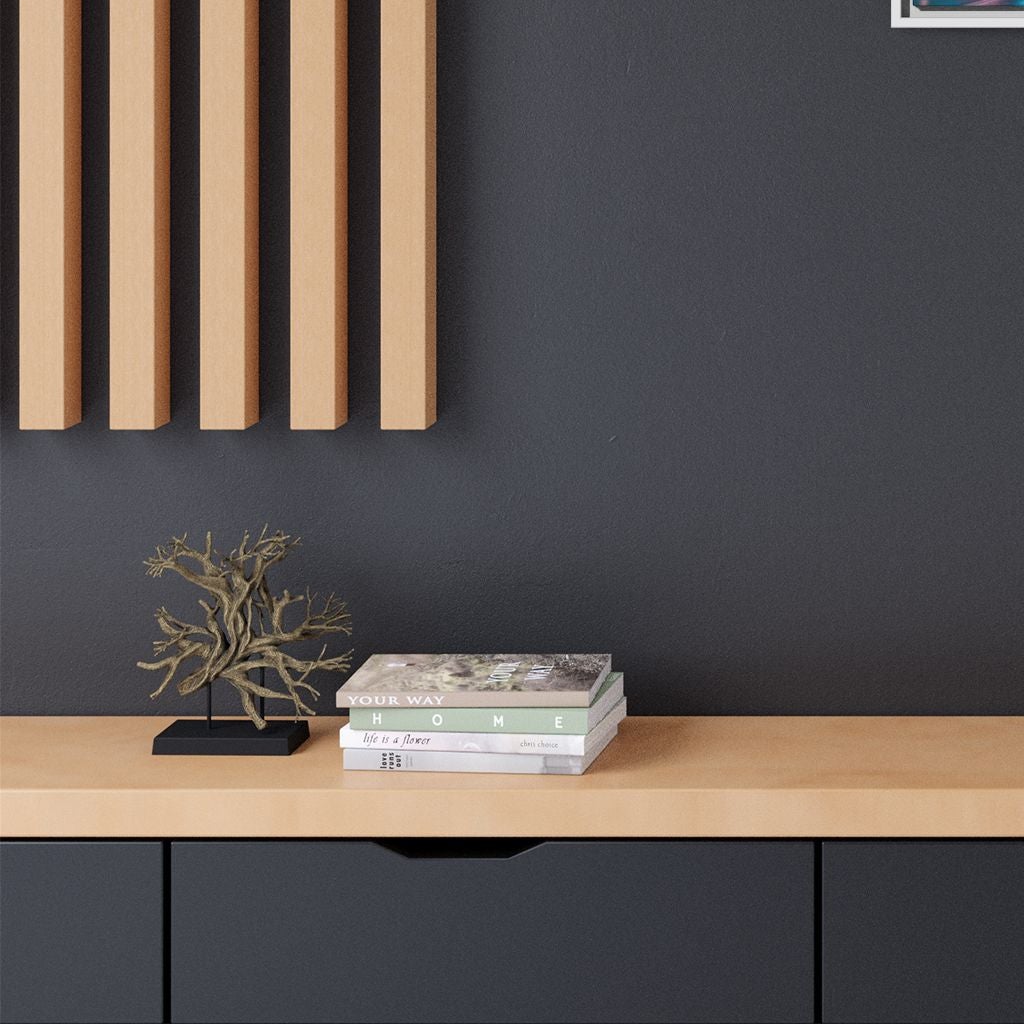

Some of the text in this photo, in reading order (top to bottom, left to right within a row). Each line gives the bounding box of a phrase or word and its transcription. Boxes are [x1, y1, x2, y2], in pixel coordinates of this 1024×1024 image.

[348, 696, 445, 705] YOUR WAY
[372, 712, 563, 729] HOME
[363, 733, 379, 747] life
[382, 735, 390, 744] is
[400, 734, 431, 748] flower
[380, 752, 388, 769] love
